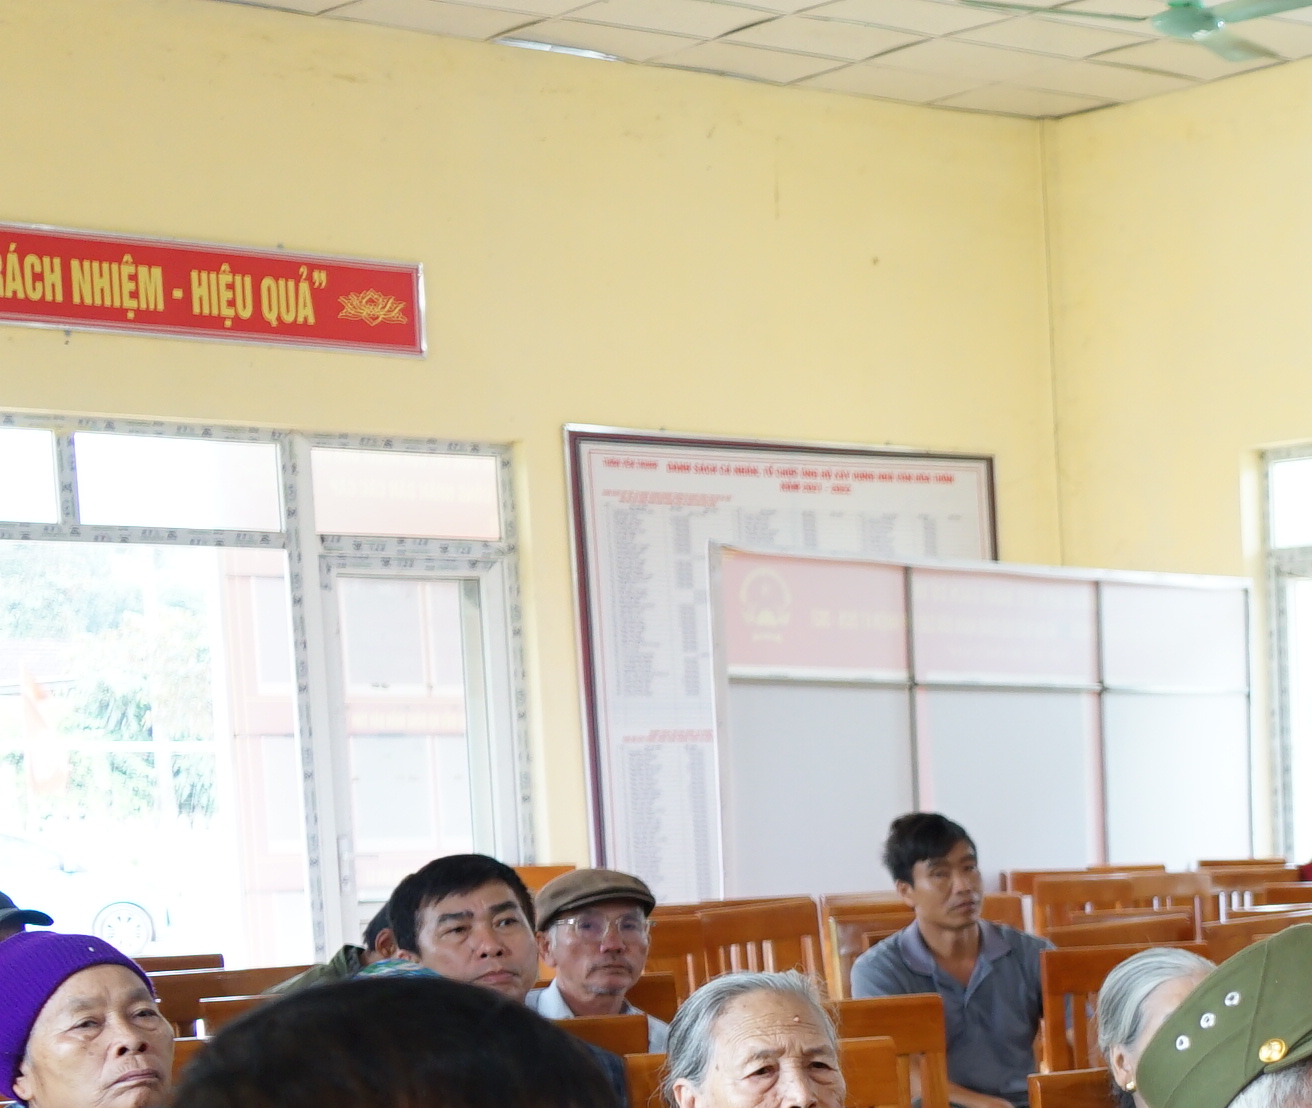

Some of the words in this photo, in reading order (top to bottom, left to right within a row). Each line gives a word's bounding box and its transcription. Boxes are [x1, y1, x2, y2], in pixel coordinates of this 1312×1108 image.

[0, 242, 63, 303] ÁCH
[70, 253, 164, 320] NHIỆM
[171, 287, 184, 300] -
[190, 262, 253, 328] HIỆU
